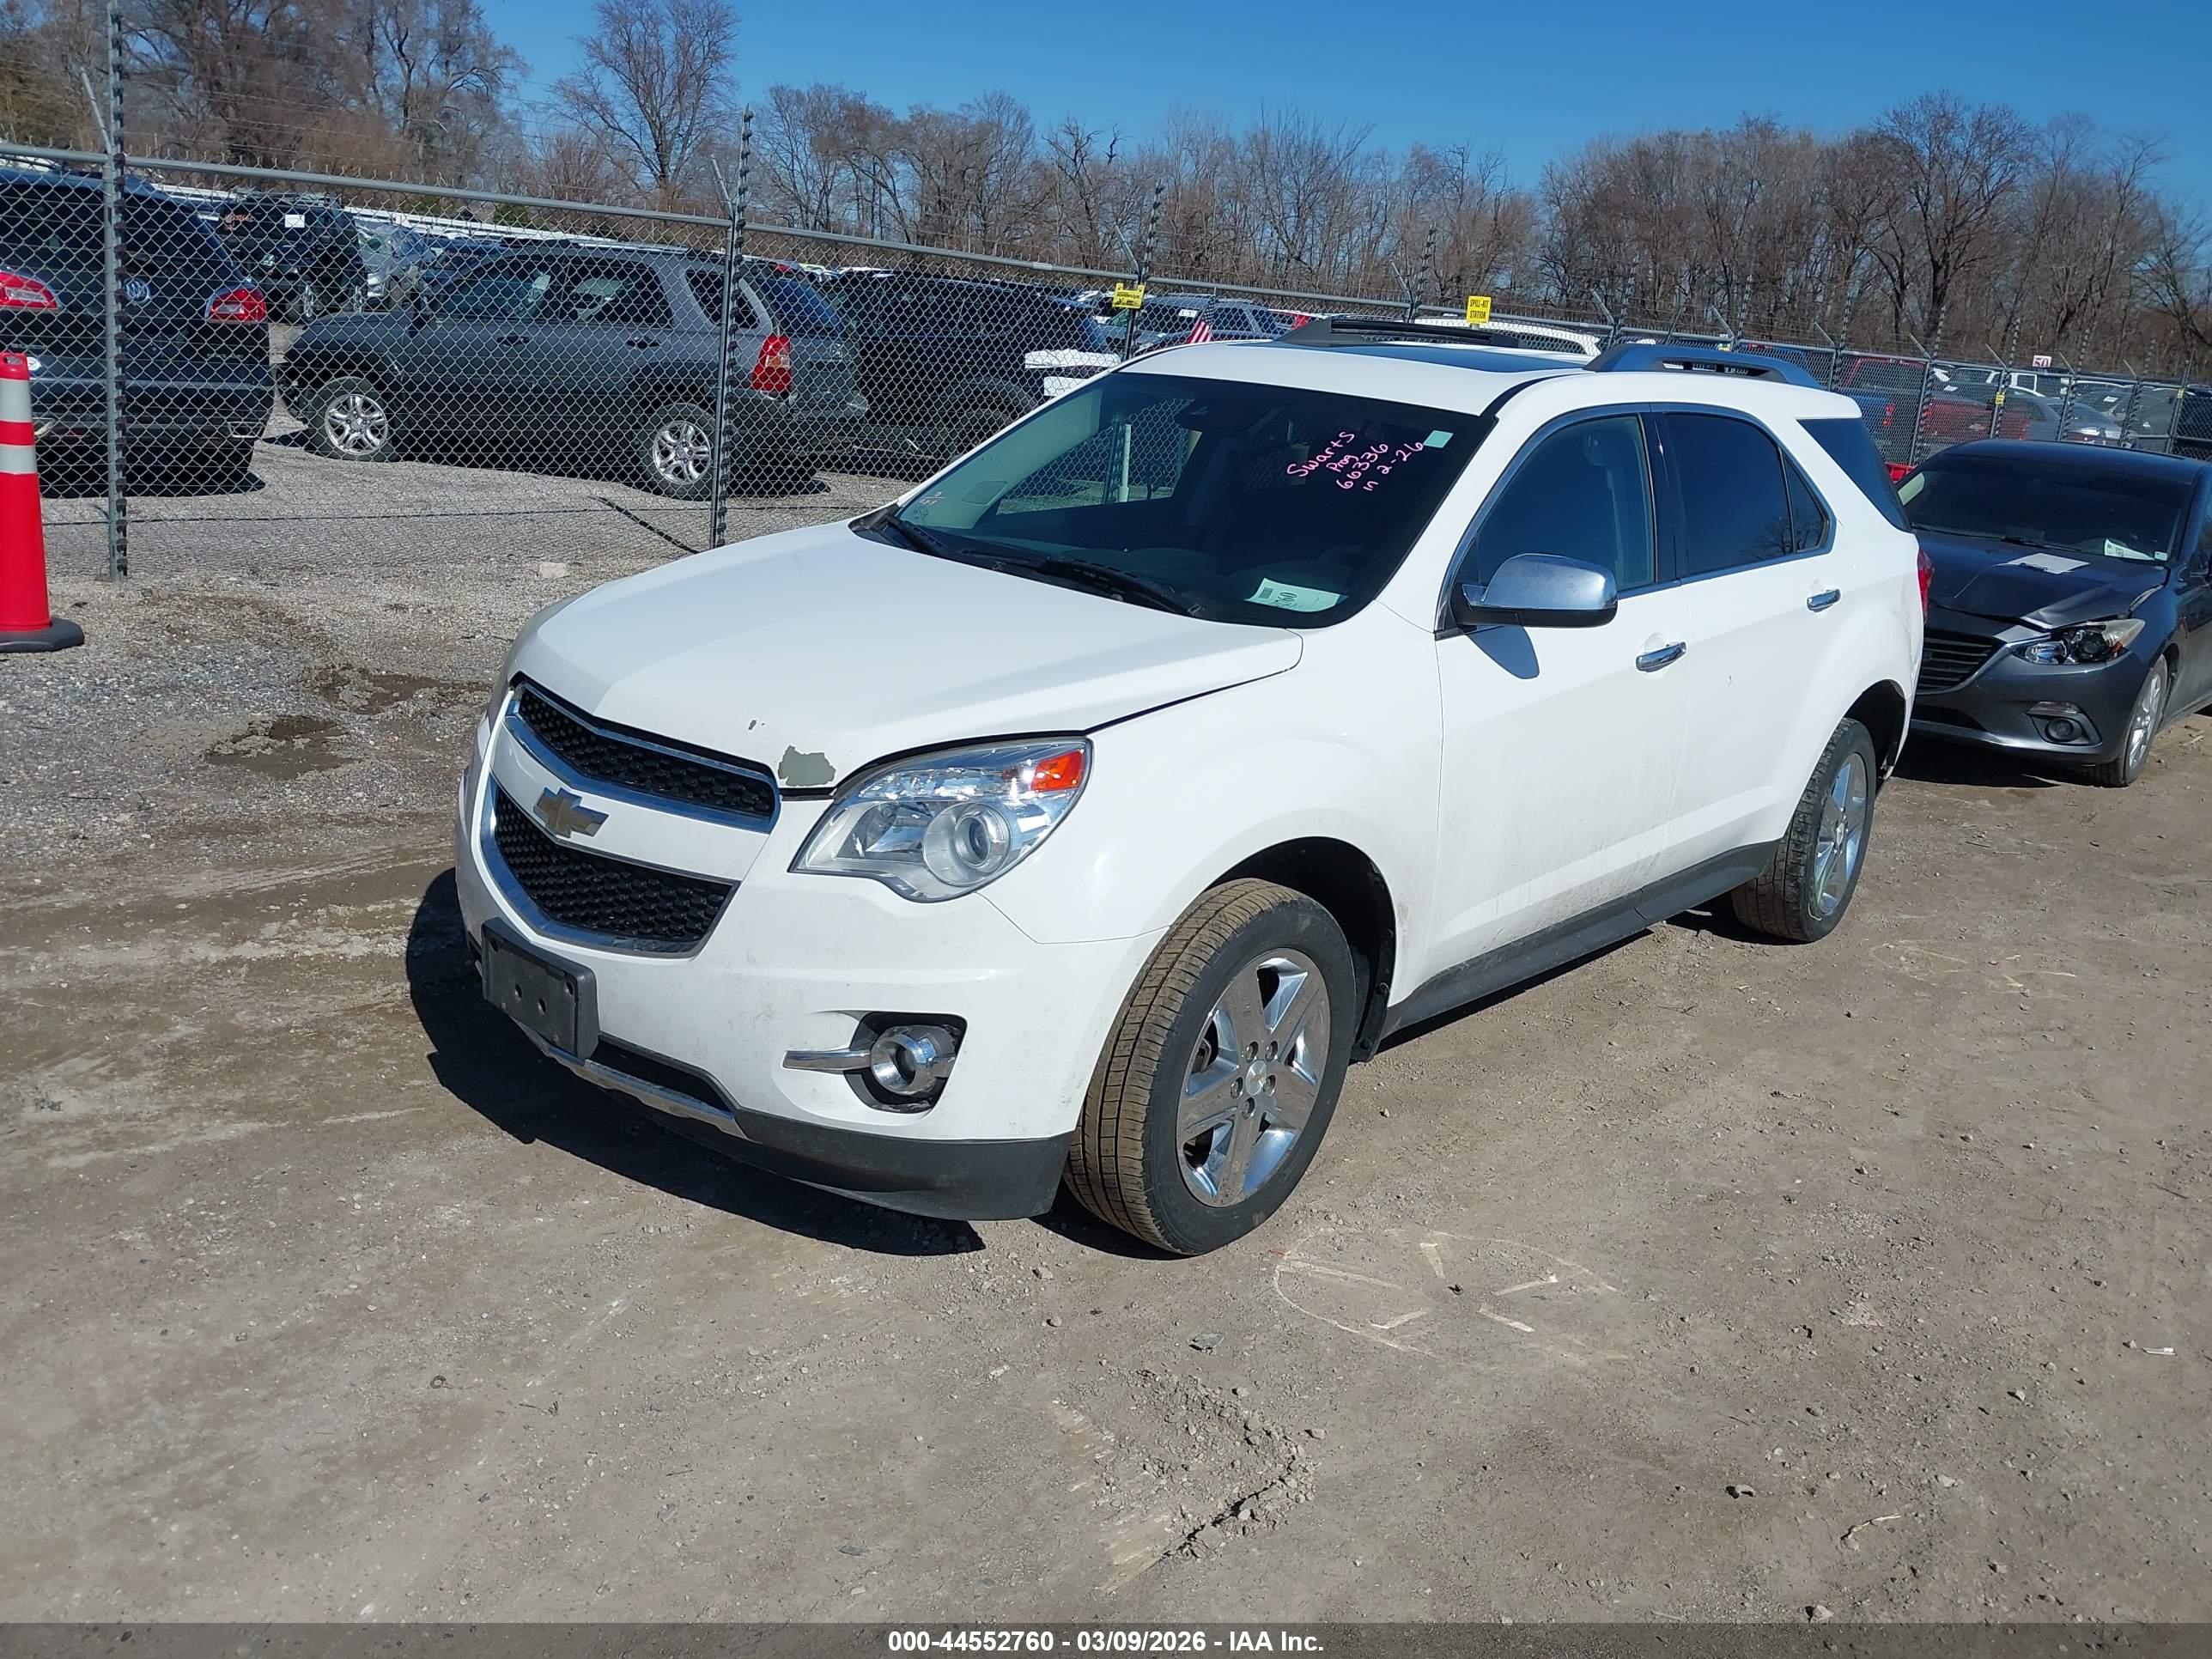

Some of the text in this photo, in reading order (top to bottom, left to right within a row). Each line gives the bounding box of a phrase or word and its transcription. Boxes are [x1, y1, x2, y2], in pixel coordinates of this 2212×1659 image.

[1469, 310, 1486, 319] STATION
[2033, 356, 2050, 367] 50
[1336, 442, 1389, 489] 66336
